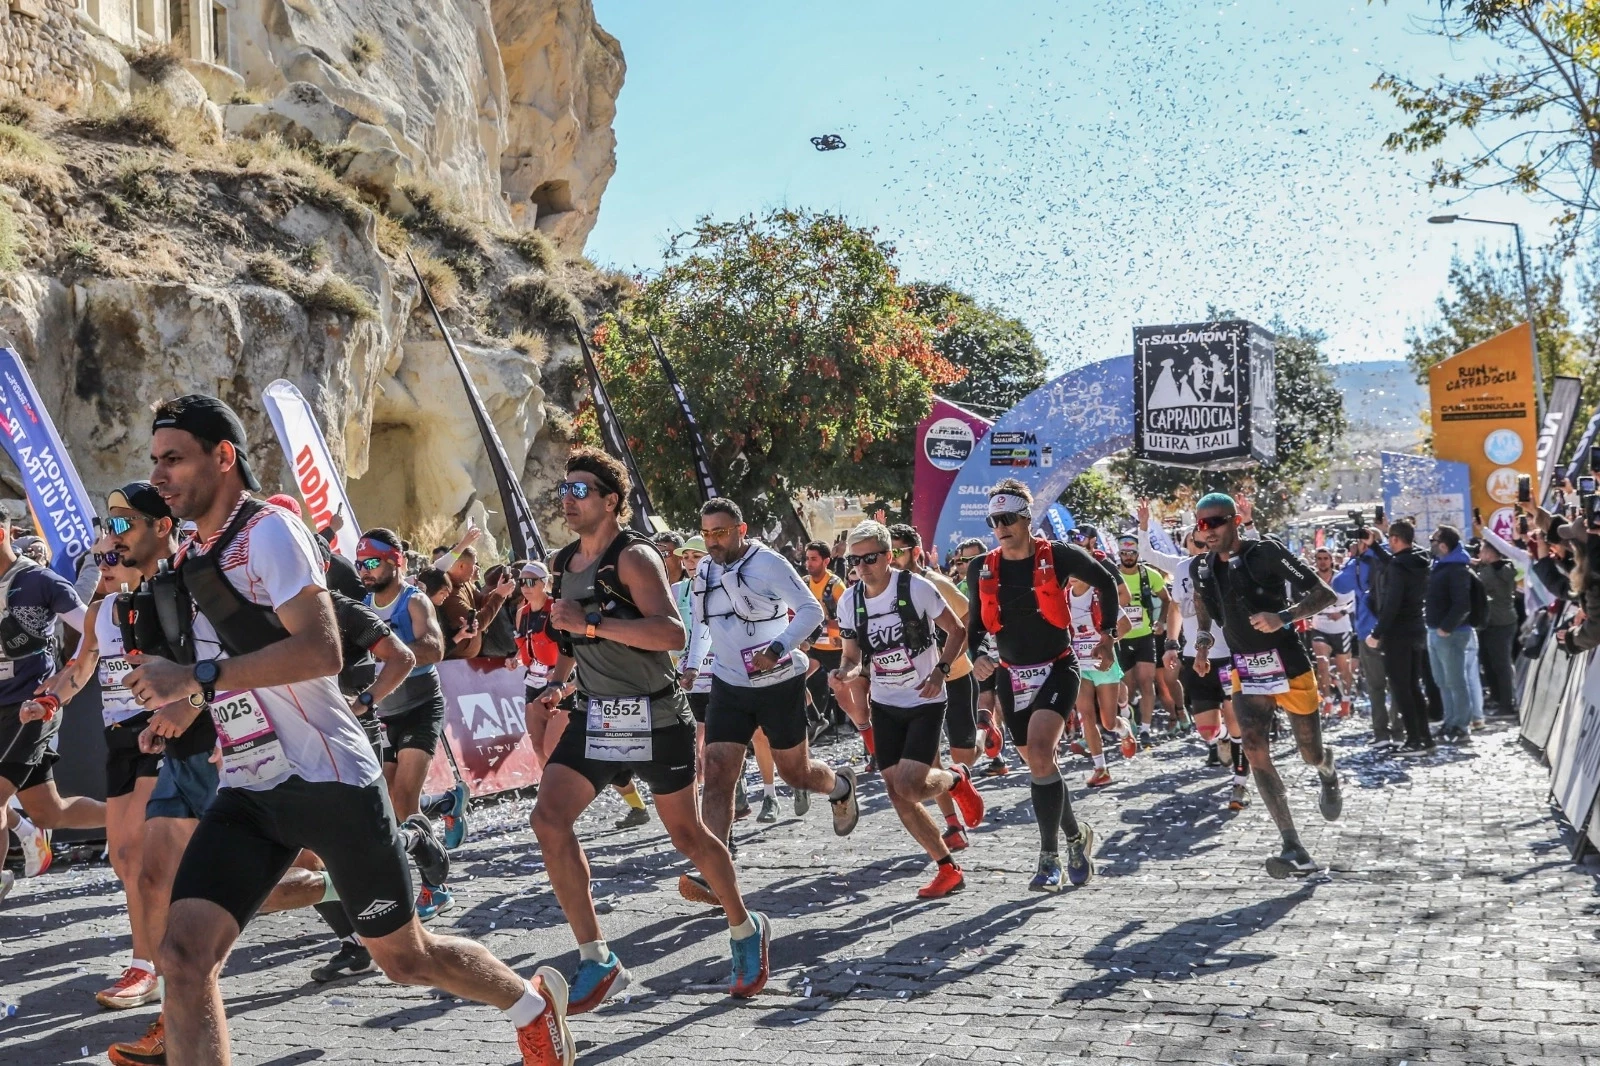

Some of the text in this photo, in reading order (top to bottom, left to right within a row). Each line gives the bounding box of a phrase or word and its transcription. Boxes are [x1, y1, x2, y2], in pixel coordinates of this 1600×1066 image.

[1150, 331, 1228, 346] SALOMON
[1458, 364, 1487, 378] RUN
[1446, 371, 1517, 392] CAPPADOCIA
[1440, 404, 1470, 412] CANLI
[1149, 407, 1233, 430] CAPPADOCIA
[1149, 432, 1232, 451] ULTRA TRAIL
[958, 485, 990, 495] SALO
[1281, 558, 1305, 580] salomon
[868, 622, 903, 649] EVE
[876, 653, 903, 665] 2032
[1247, 655, 1275, 667] 2965
[1019, 668, 1047, 678] 2054
[214, 697, 252, 724] 2025
[603, 703, 641, 716] 6552
[378, 904, 399, 916] TRAIL
[544, 1010, 564, 1060] TERREX
